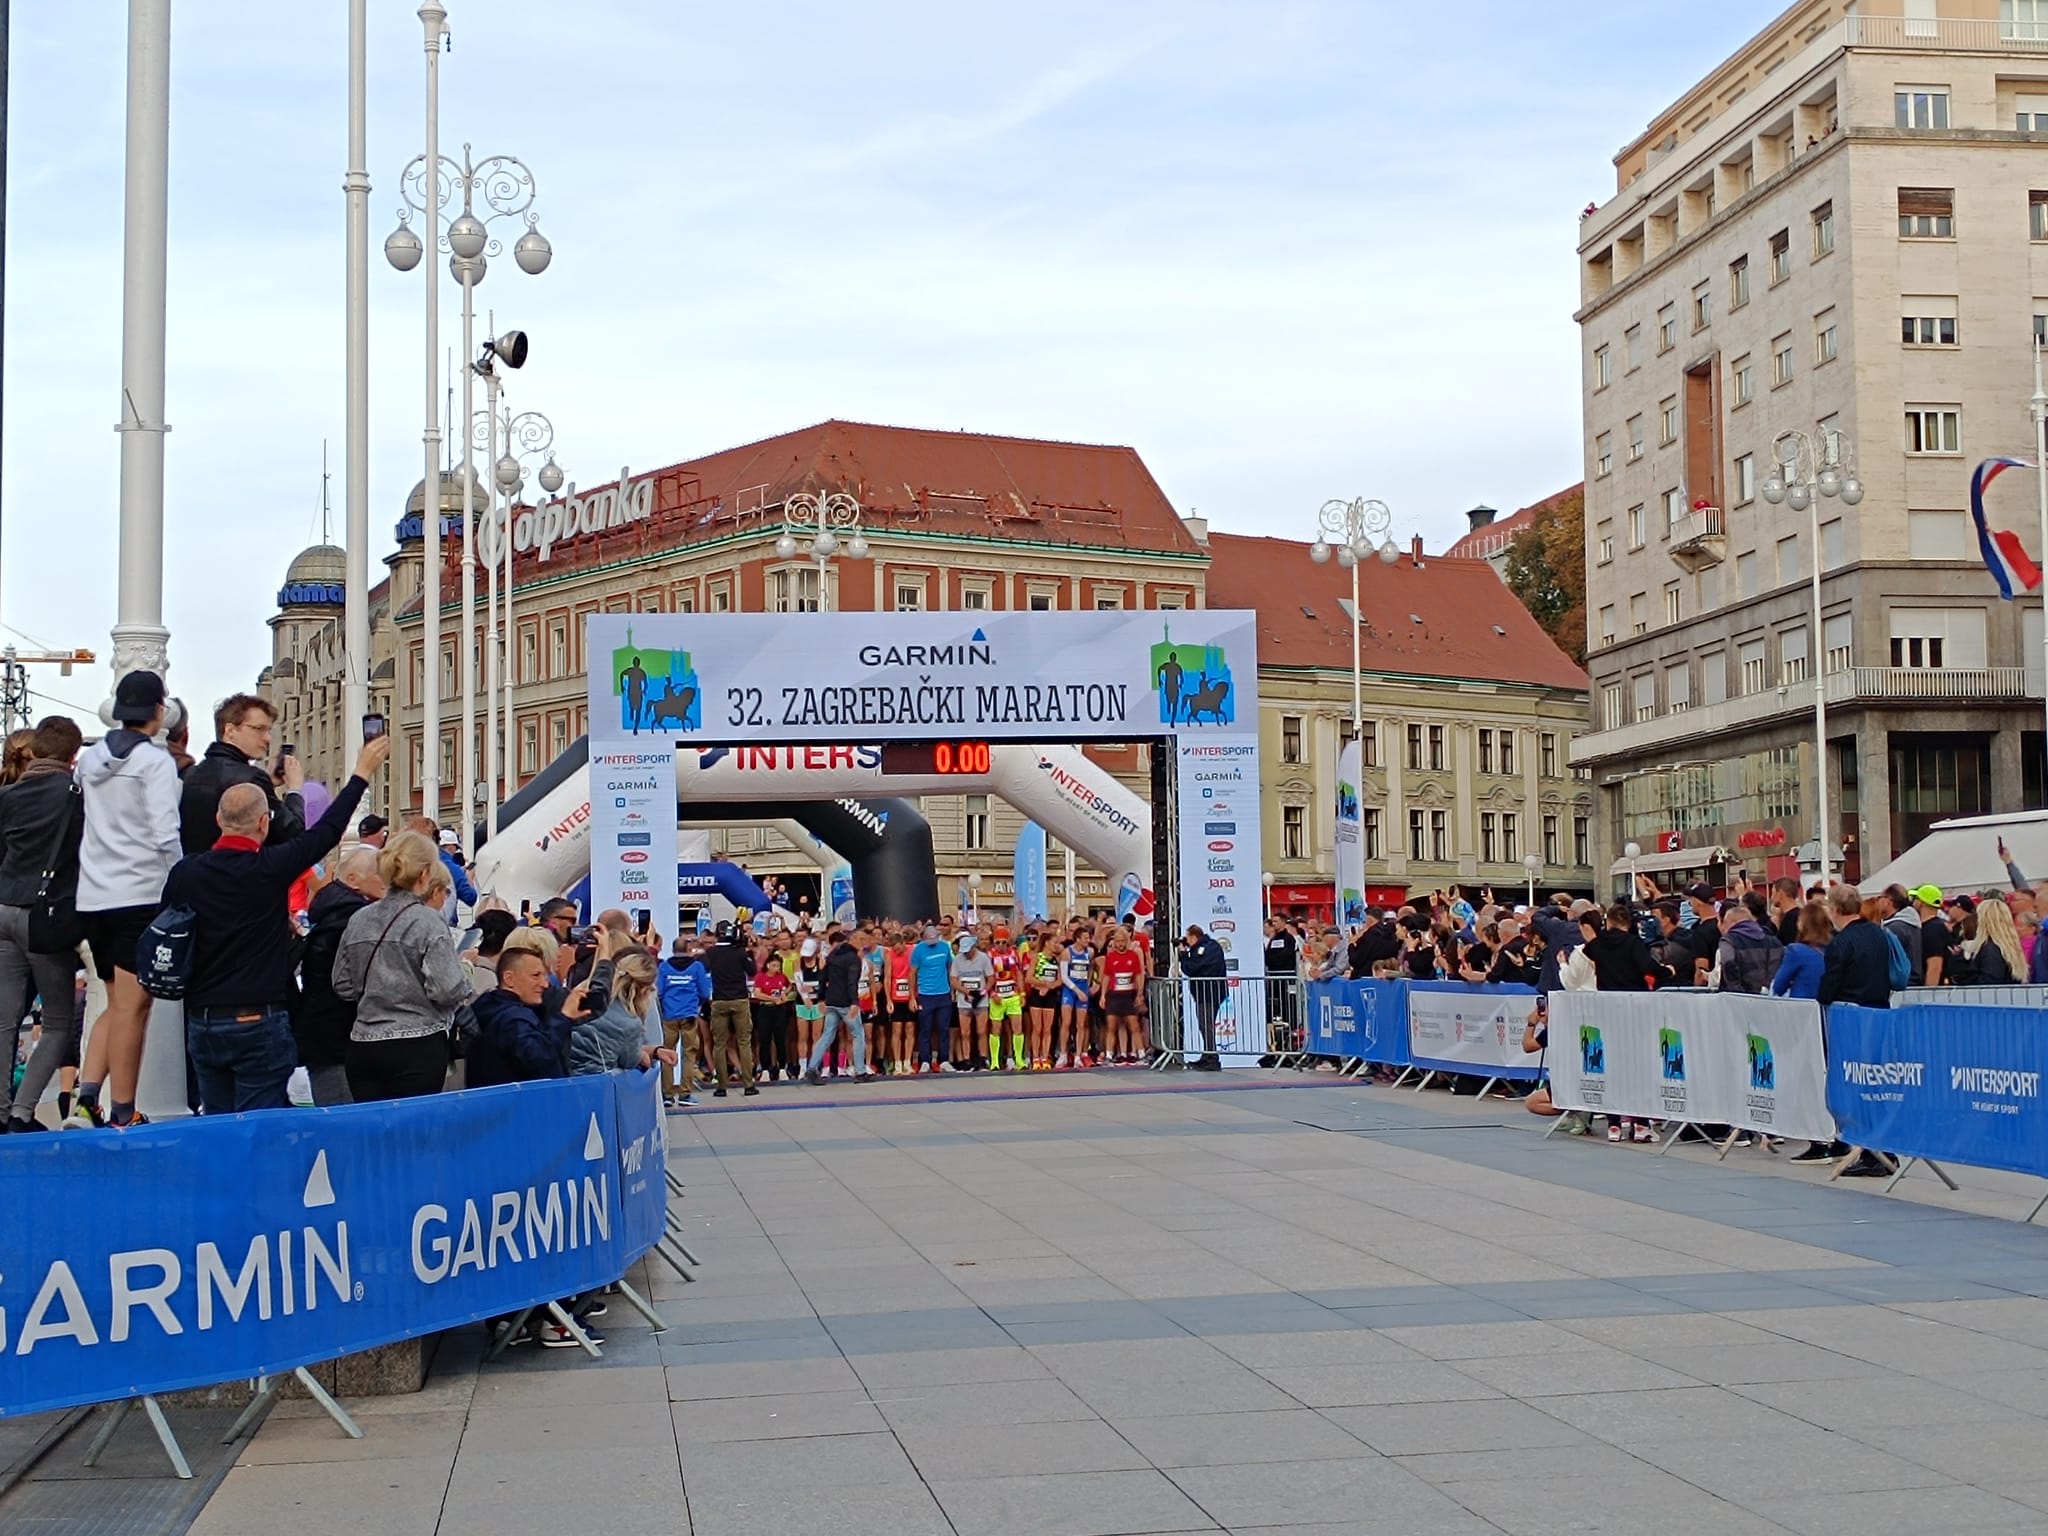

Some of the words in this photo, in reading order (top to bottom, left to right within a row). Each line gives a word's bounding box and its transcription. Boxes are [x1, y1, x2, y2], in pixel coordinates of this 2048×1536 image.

[859, 645, 991, 666] GARMIN
[727, 687, 773, 726] 32.
[782, 674, 965, 725] ZAGREBAČKI
[976, 684, 1127, 723] MARATON
[604, 755, 671, 764] INTERSPORT
[1192, 746, 1255, 756] INTERSPORT
[607, 781, 657, 790] GARMIN
[1194, 773, 1242, 781] GARMIN
[1050, 767, 1140, 835] INTERSPORT
[1963, 1067, 2039, 1097] INTERSPORT
[411, 1173, 609, 1285] GARMIN
[0, 1220, 351, 1356] ARMIN
